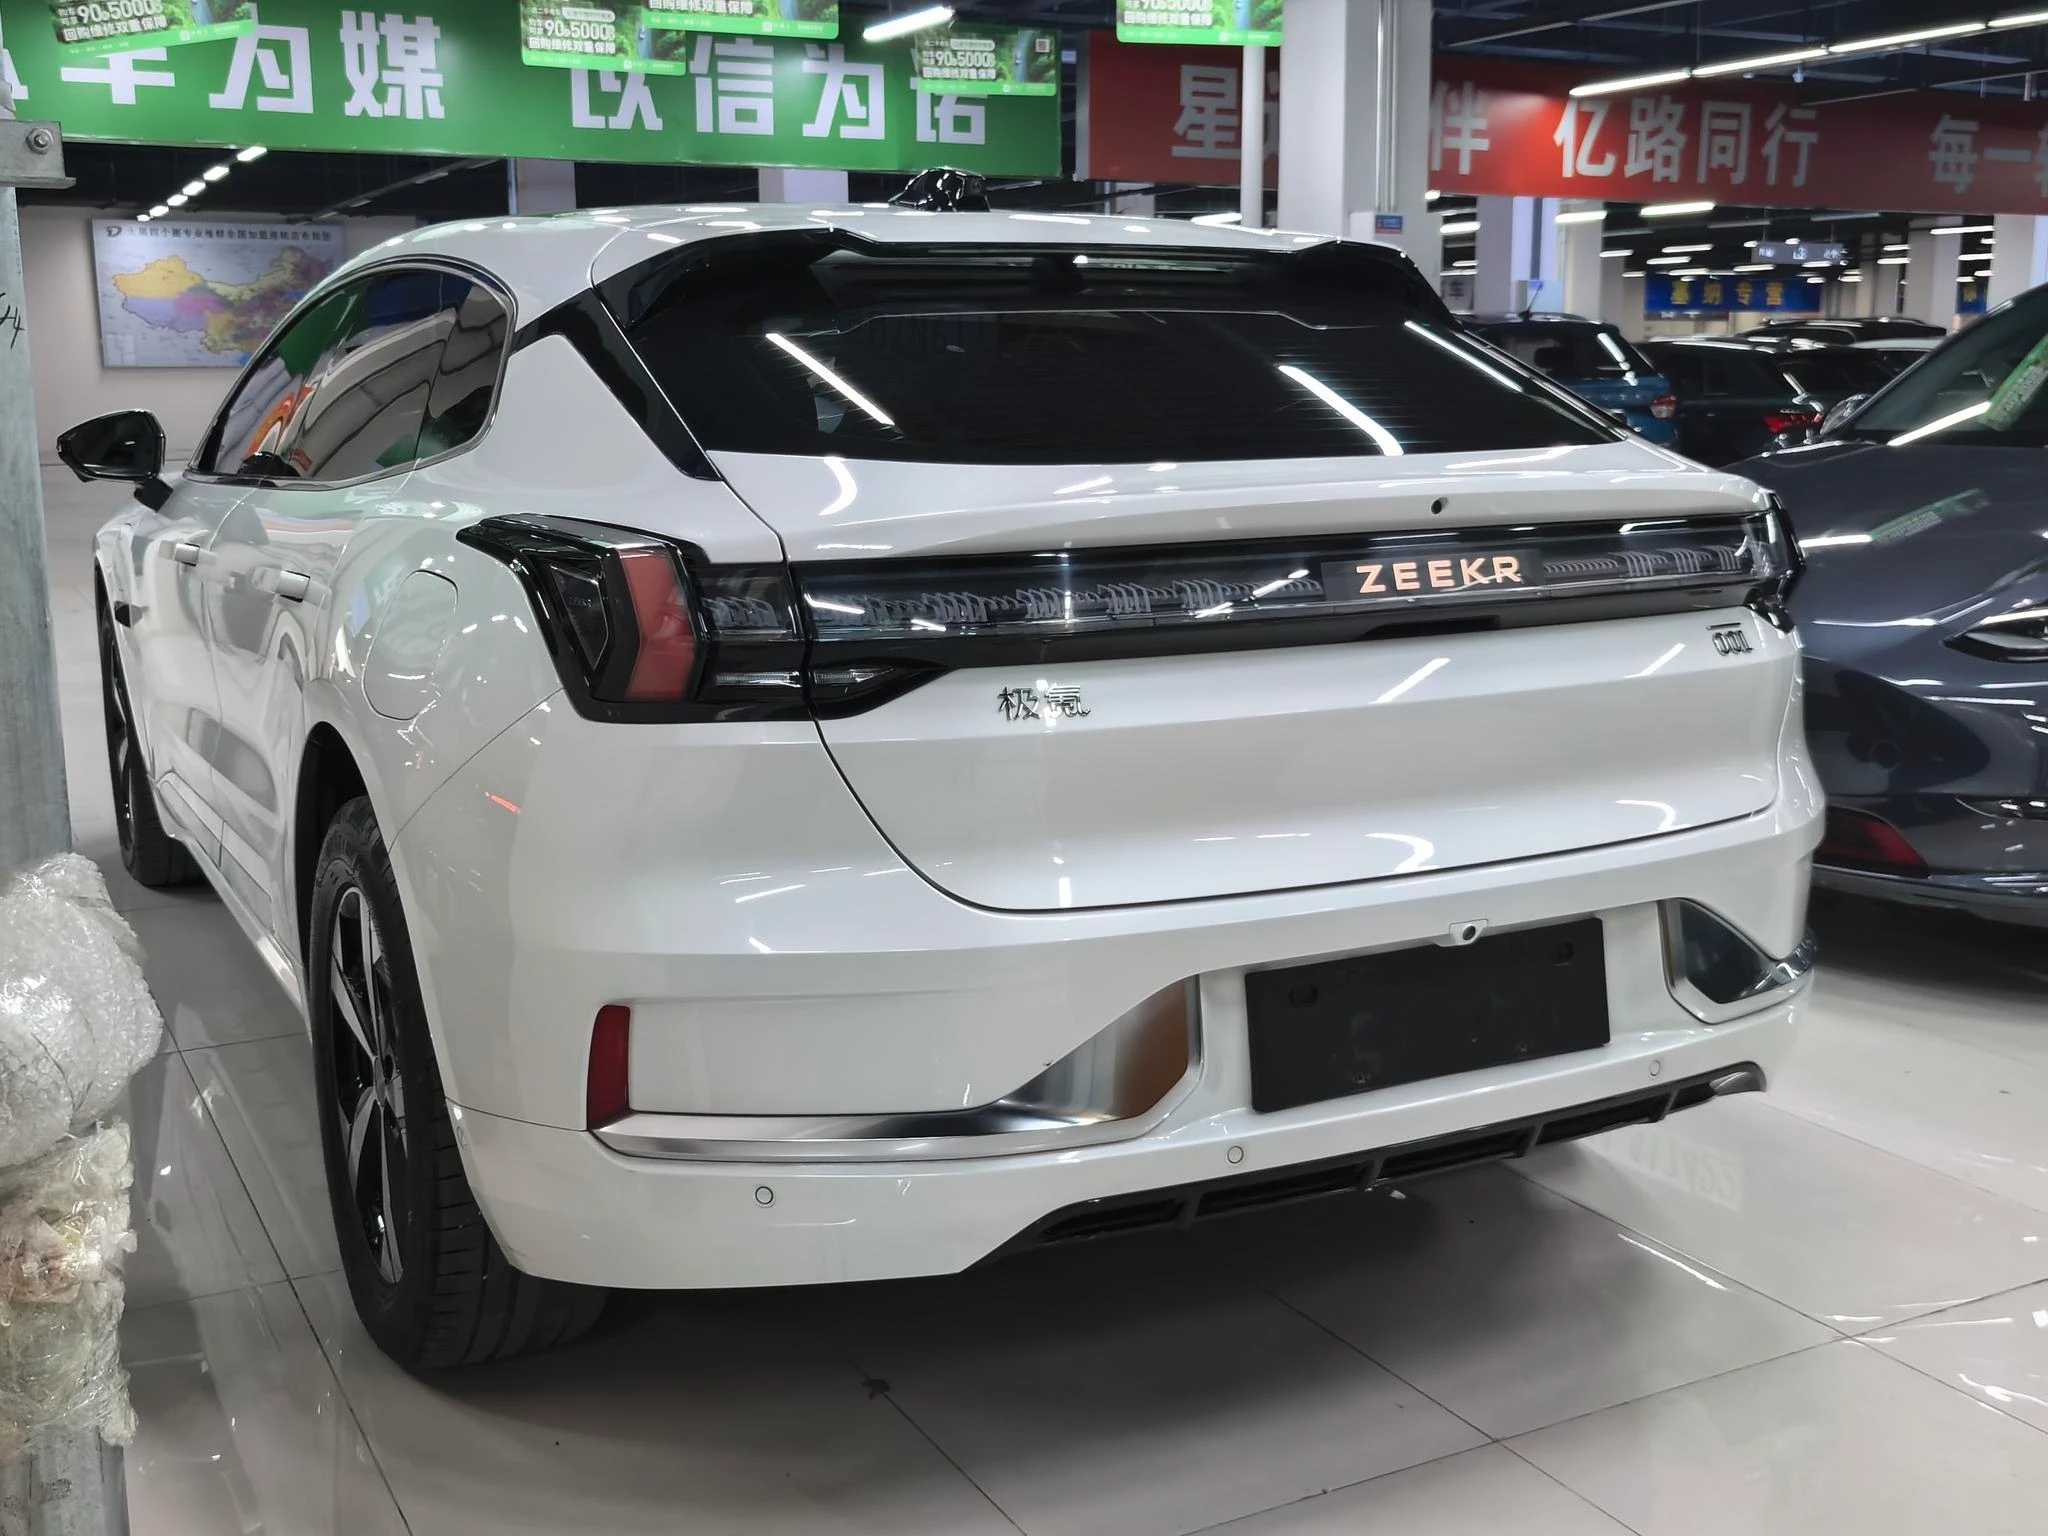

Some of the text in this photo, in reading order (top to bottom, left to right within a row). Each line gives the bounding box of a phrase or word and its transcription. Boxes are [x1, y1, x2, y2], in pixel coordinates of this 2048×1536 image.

[3, 4, 446, 120] 车为媒
[1553, 95, 1820, 188] 亿路同行
[1356, 555, 1523, 594] ZEEKR
[997, 682, 1092, 721] 极氪
